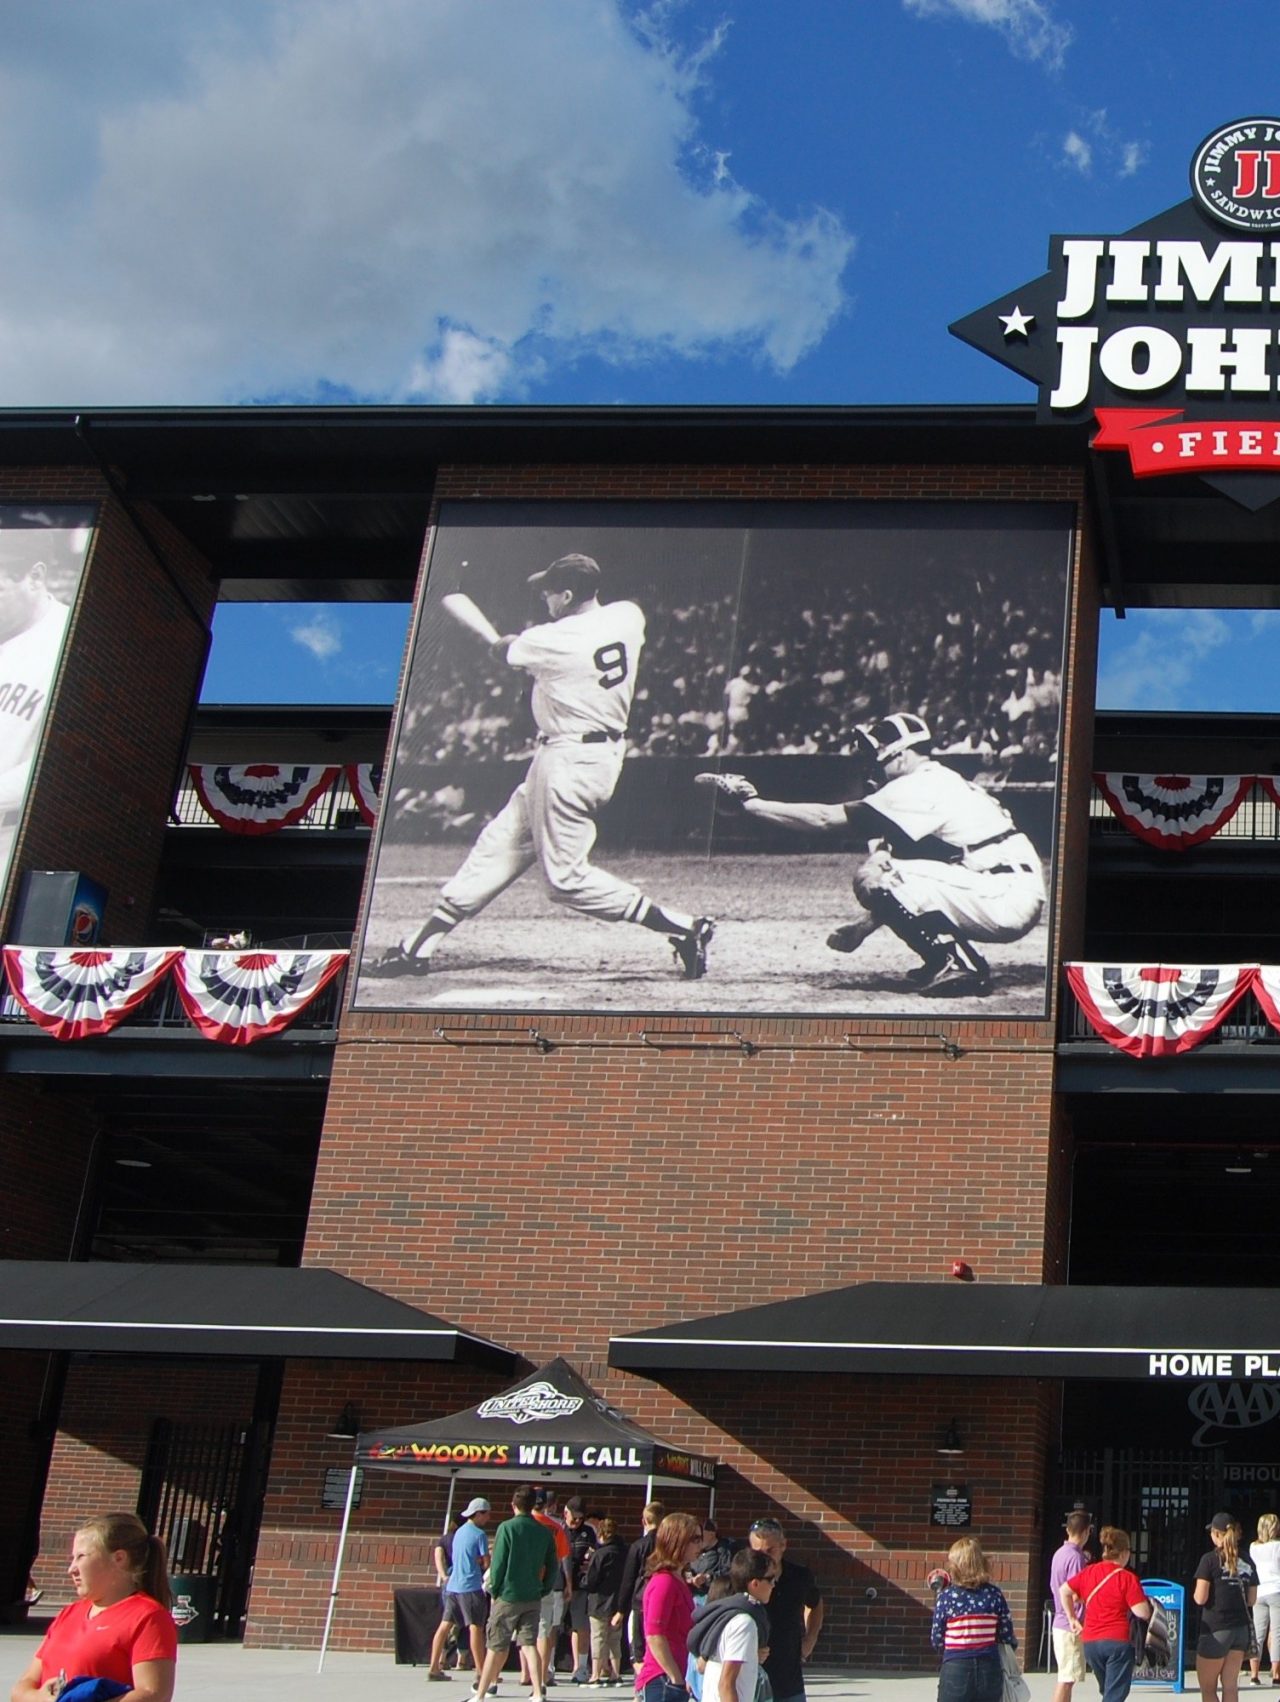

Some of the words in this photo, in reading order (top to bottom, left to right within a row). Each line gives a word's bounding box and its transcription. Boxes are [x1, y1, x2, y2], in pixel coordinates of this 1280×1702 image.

[1204, 127, 1257, 173] JIMMY
[593, 641, 628, 690] 9
[1150, 1354, 1232, 1376] HOME
[1198, 1382, 1275, 1427] AAA
[411, 1442, 509, 1465] WOODY'S
[519, 1444, 575, 1466] WILL
[581, 1446, 641, 1468] CALL
